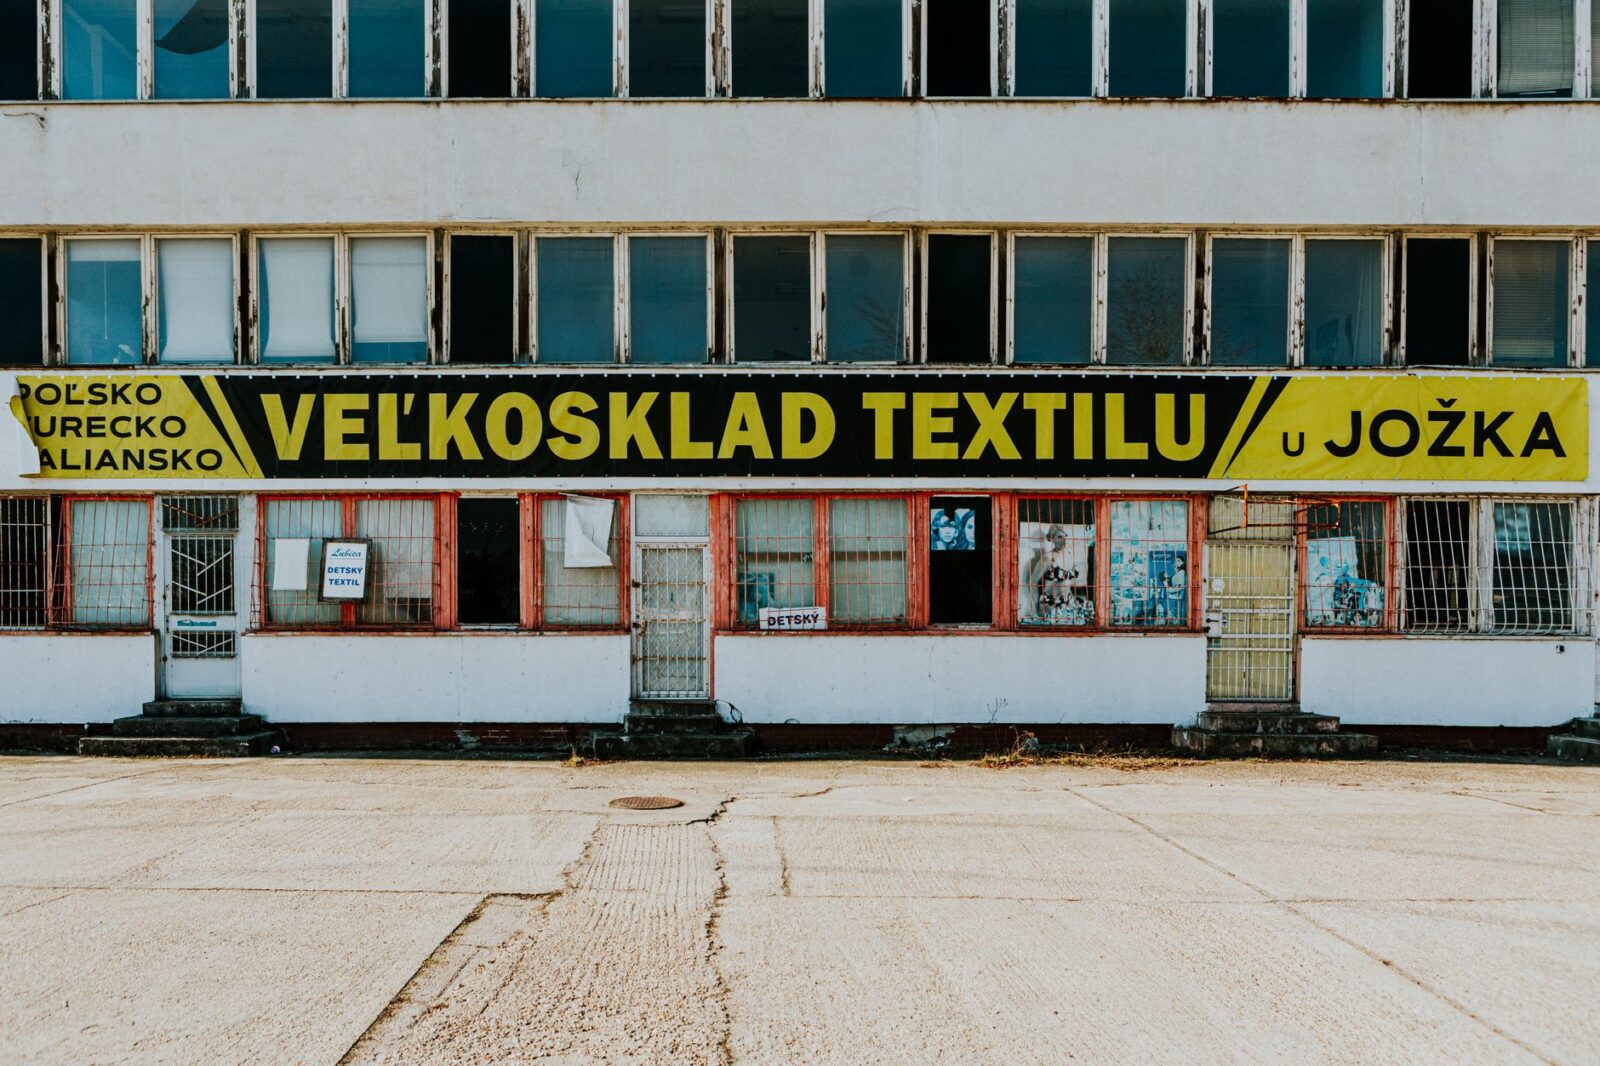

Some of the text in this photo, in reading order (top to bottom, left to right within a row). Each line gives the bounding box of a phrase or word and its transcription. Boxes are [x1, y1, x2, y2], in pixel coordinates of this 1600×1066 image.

[27, 415, 187, 438] URECKO
[260, 391, 1206, 461] VEĽKOSKLAD TEXTILU
[1324, 398, 1567, 458] JOŽKA
[39, 448, 223, 471] ALIANSKO
[328, 578, 360, 586] TEXTIL
[767, 611, 819, 626] DETSKÝ
